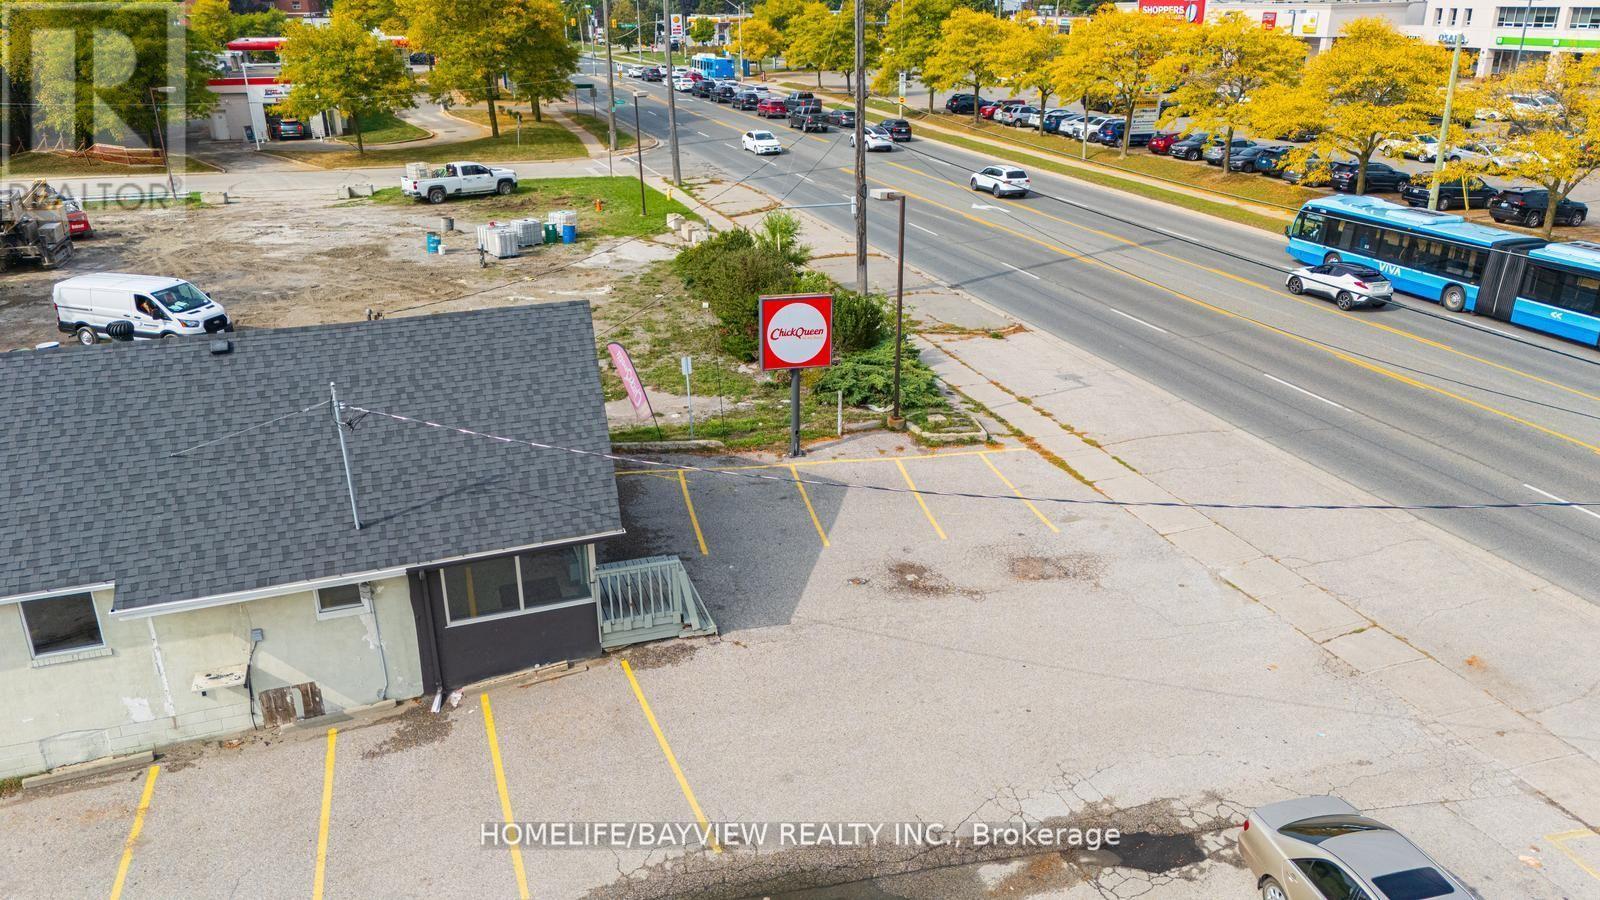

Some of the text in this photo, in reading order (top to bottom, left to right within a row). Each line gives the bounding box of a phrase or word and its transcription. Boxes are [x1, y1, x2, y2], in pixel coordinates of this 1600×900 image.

[1142, 5, 1185, 14] SHOPPERS
[1438, 34, 1466, 44] OSAA
[1379, 261, 1401, 277] VIVA
[770, 327, 824, 340] ChickQueen
